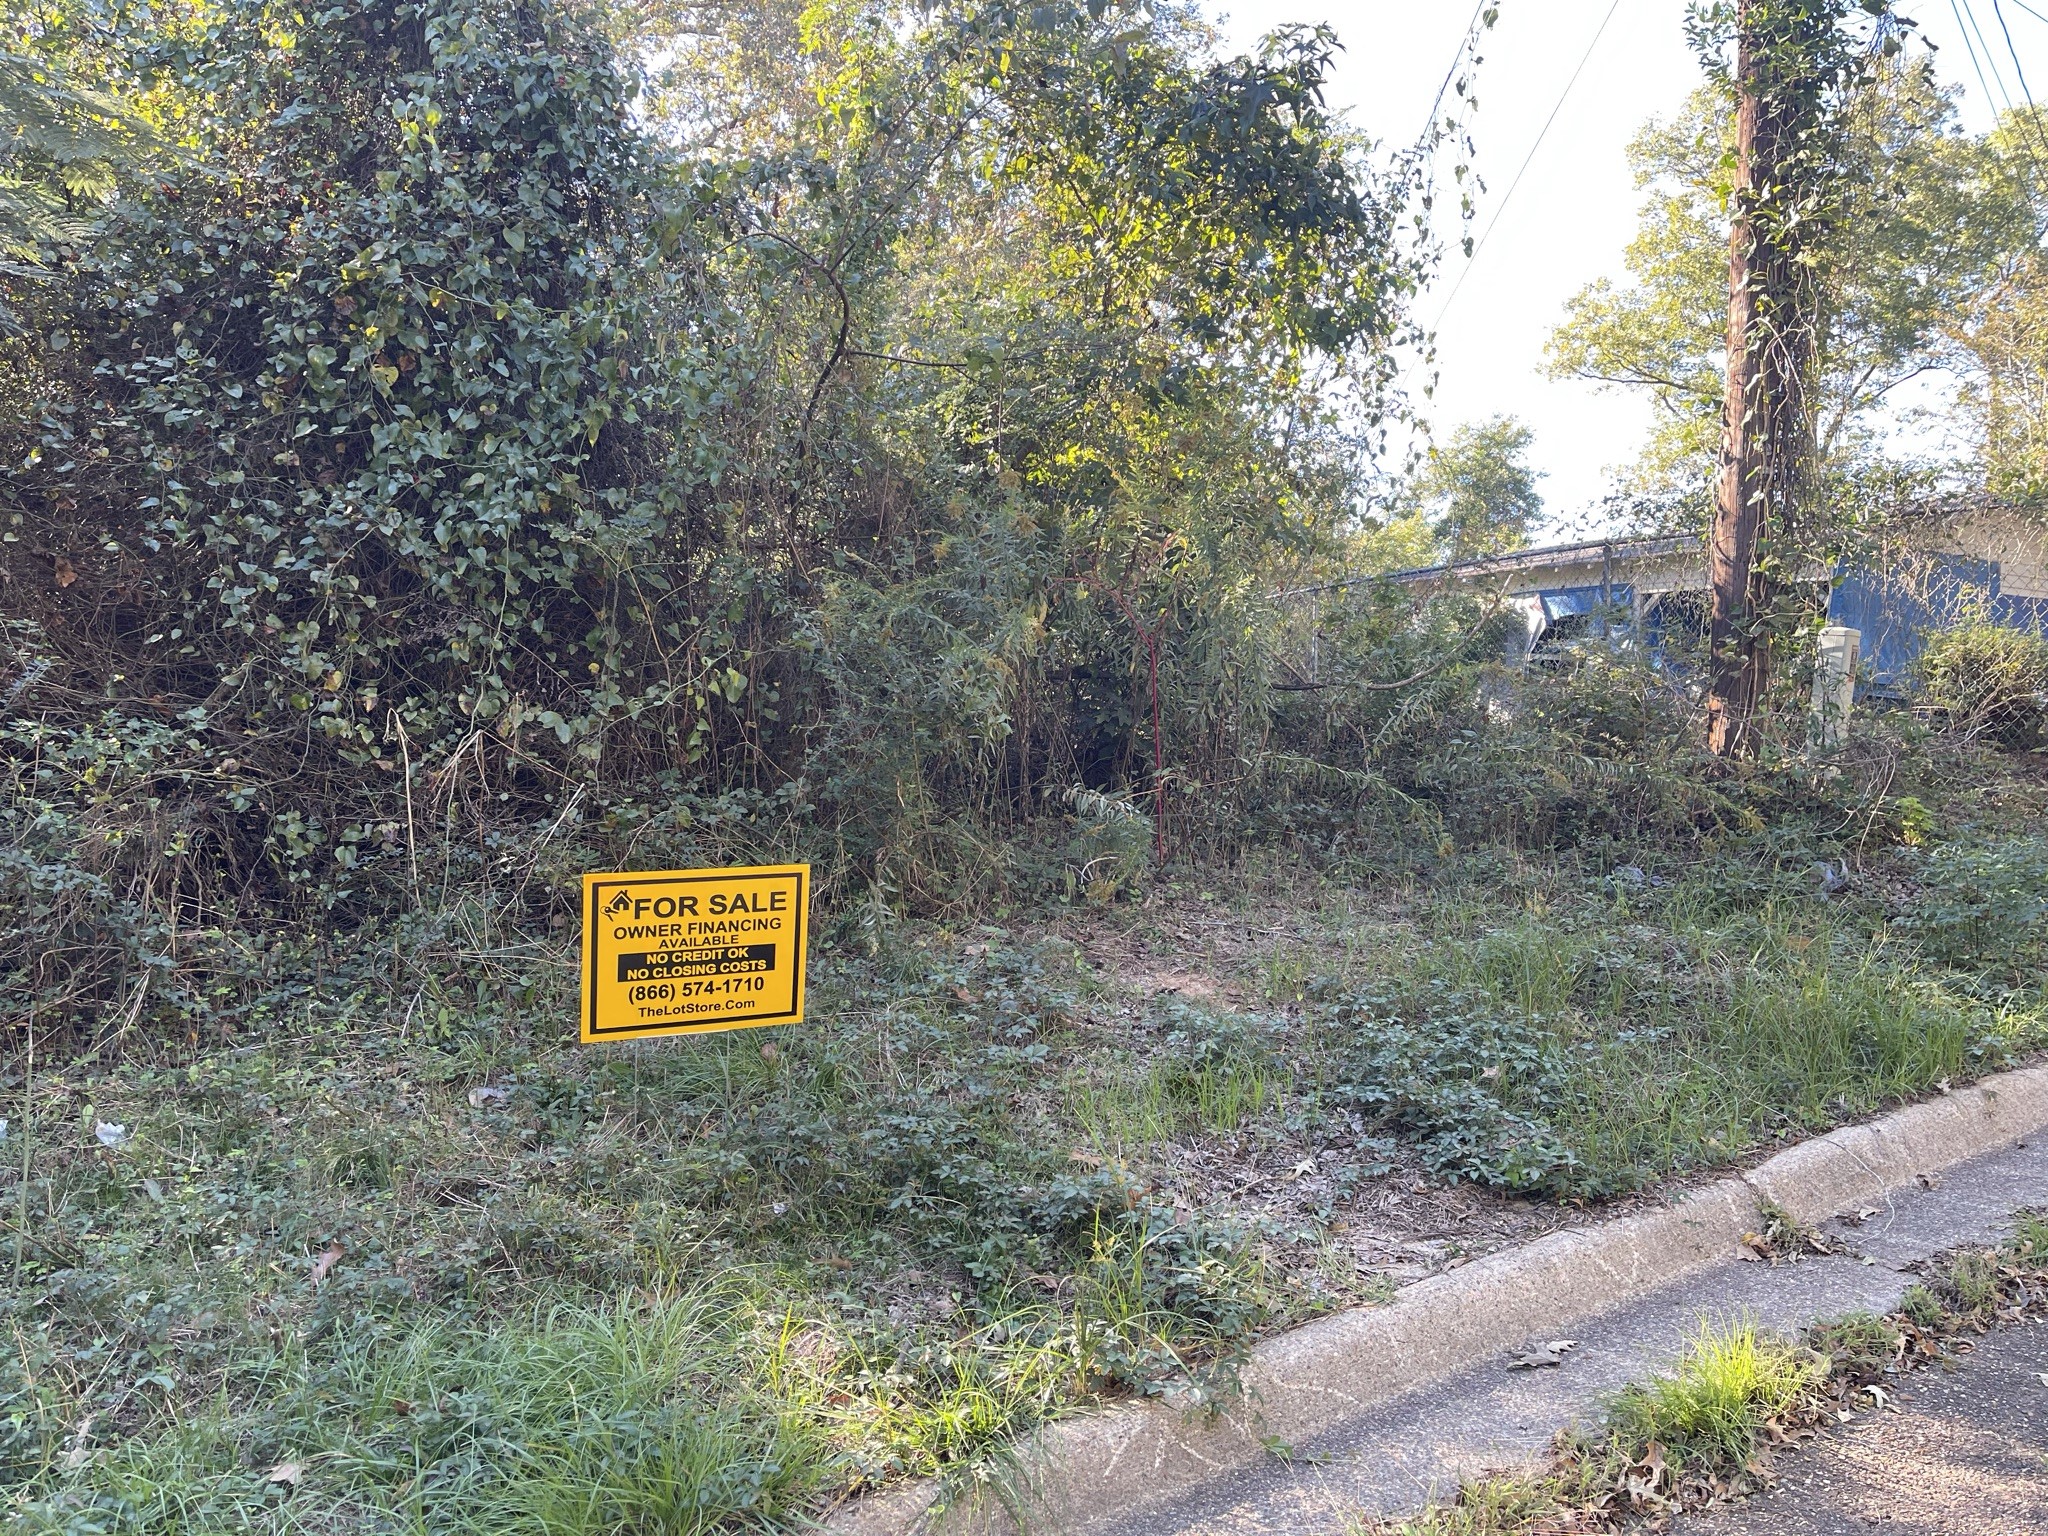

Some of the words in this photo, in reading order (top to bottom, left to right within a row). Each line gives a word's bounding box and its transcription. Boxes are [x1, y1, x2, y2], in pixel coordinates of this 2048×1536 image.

[634, 896, 698, 919] FOR
[709, 891, 787, 914] SALE
[614, 924, 682, 939] OWNER
[688, 918, 781, 935] FINANCING
[659, 935, 739, 949] AVAILABLE
[646, 953, 667, 965] NO
[672, 949, 724, 963] CREDIT
[728, 947, 749, 958] OK
[627, 968, 649, 980] NO
[653, 963, 717, 978] CLOSING
[720, 960, 767, 973] COSTS
[628, 983, 676, 1005] (866)
[682, 977, 764, 997] 574-1710
[638, 1000, 755, 1018] TheLotStore.Com
